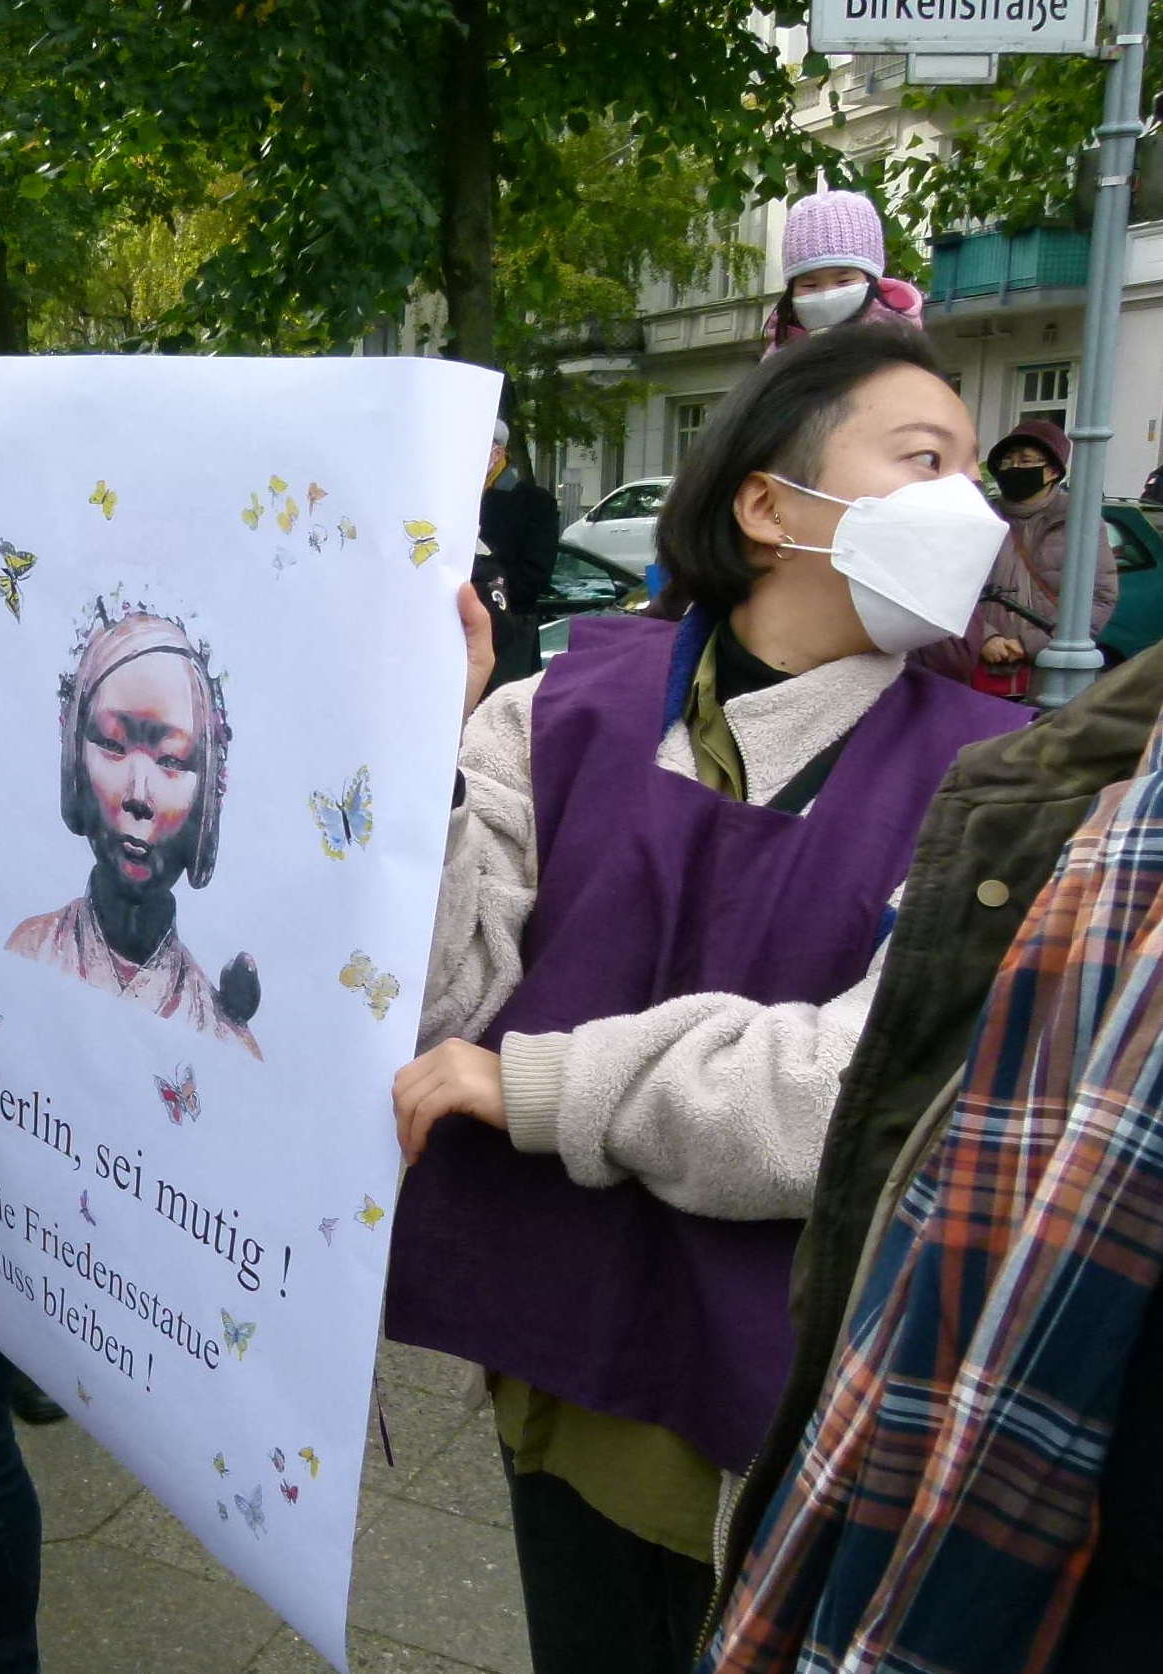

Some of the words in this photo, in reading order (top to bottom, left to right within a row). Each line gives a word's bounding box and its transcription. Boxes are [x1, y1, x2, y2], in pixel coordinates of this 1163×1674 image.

[23, 1203, 221, 1370] Friedensstatue
[95, 1143, 143, 1202] sei
[154, 1177, 265, 1292] mutig
[278, 1245, 292, 1299] !
[42, 1275, 135, 1380] bleiben
[145, 1352, 155, 1393] !
